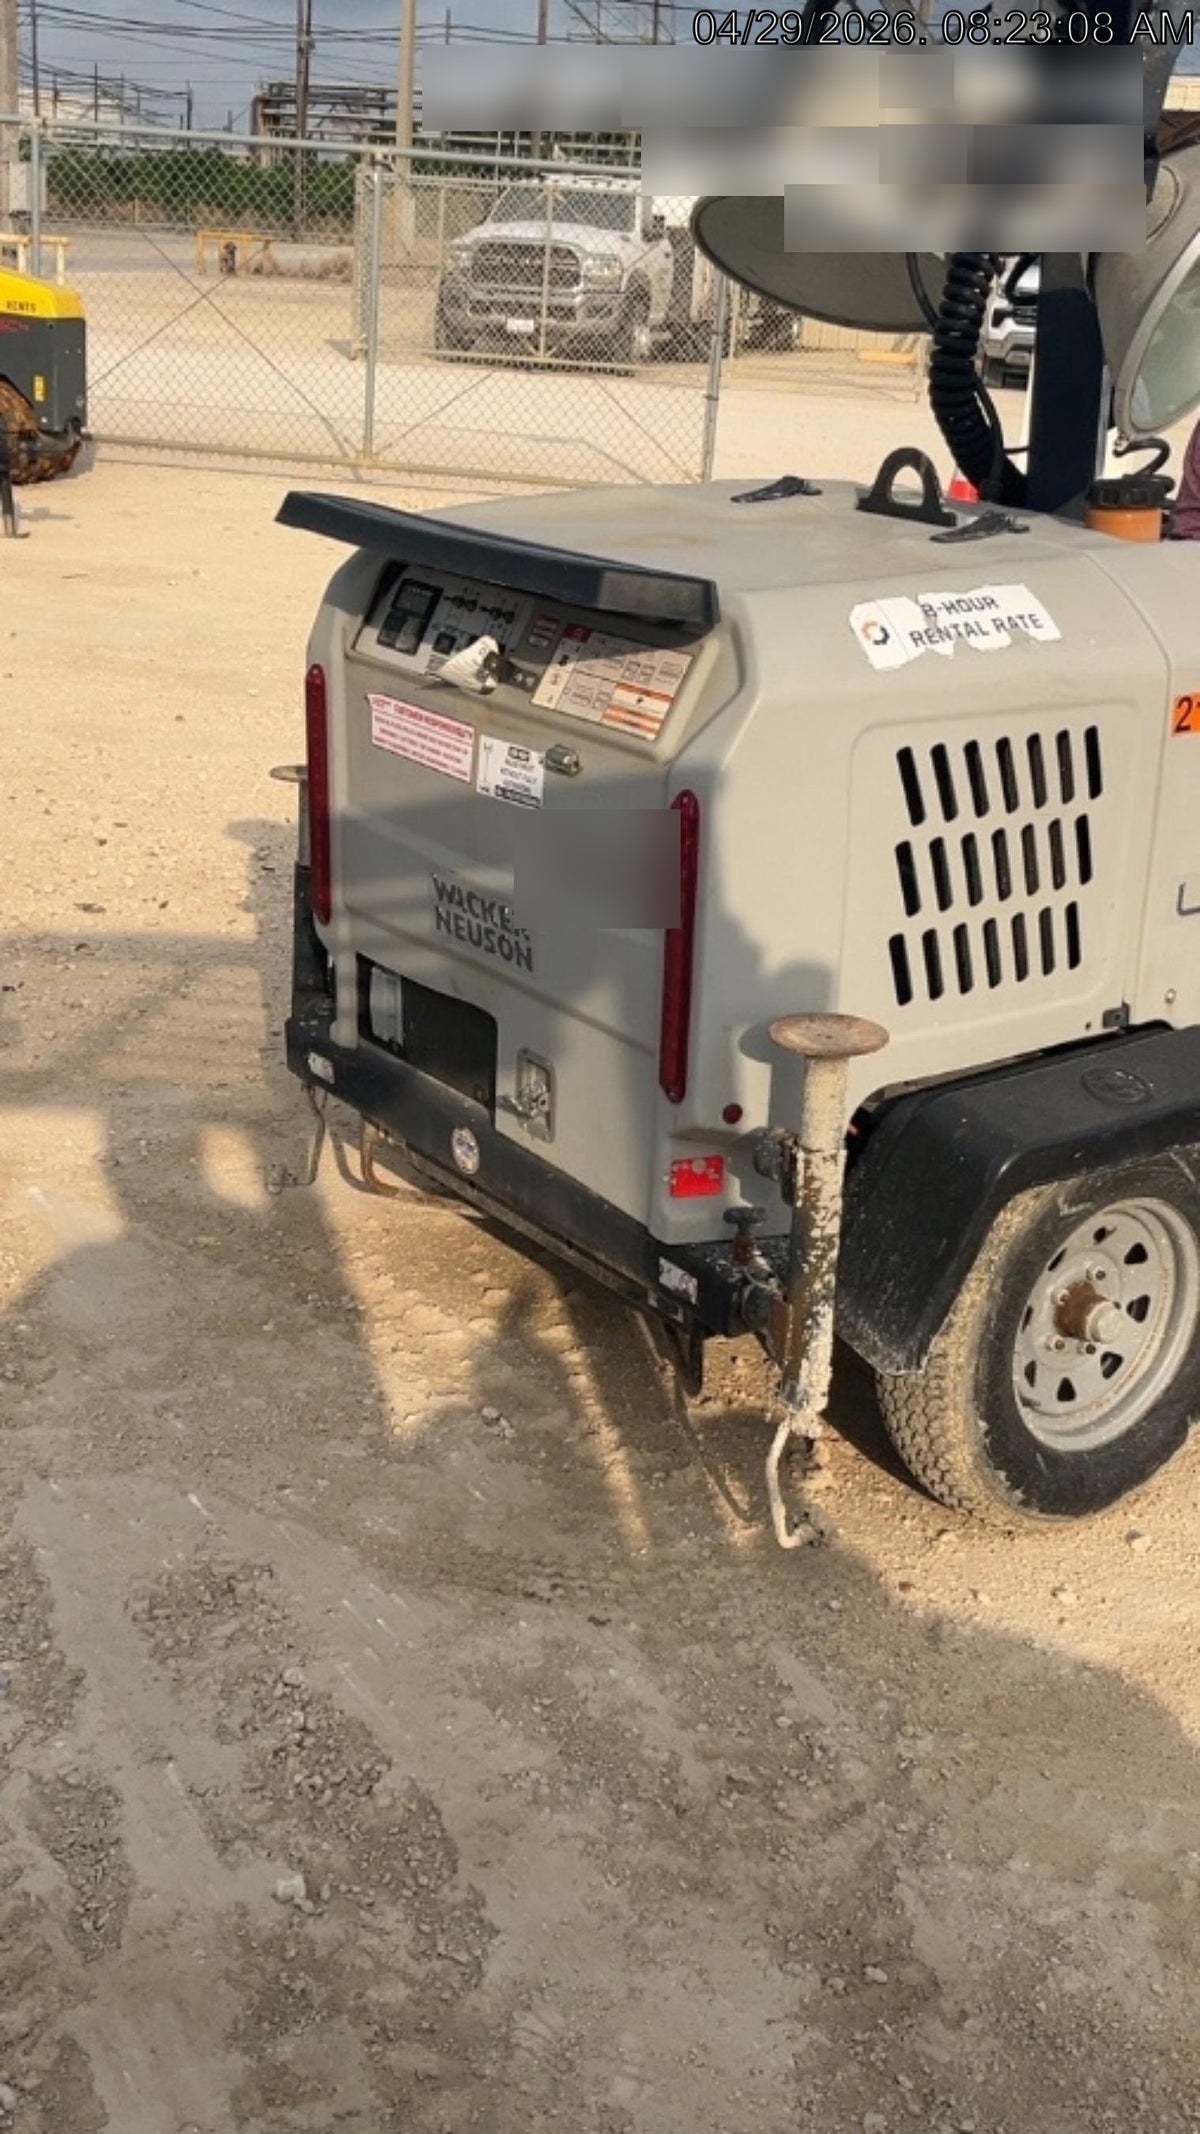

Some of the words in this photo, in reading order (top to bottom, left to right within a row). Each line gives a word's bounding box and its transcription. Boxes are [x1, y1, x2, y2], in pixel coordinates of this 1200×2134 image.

[908, 622, 990, 648] RENTAL
[991, 613, 1044, 634] RATE
[1176, 696, 1200, 733] 2
[432, 874, 530, 941] WACKE
[434, 905, 532, 972] NEUSON
